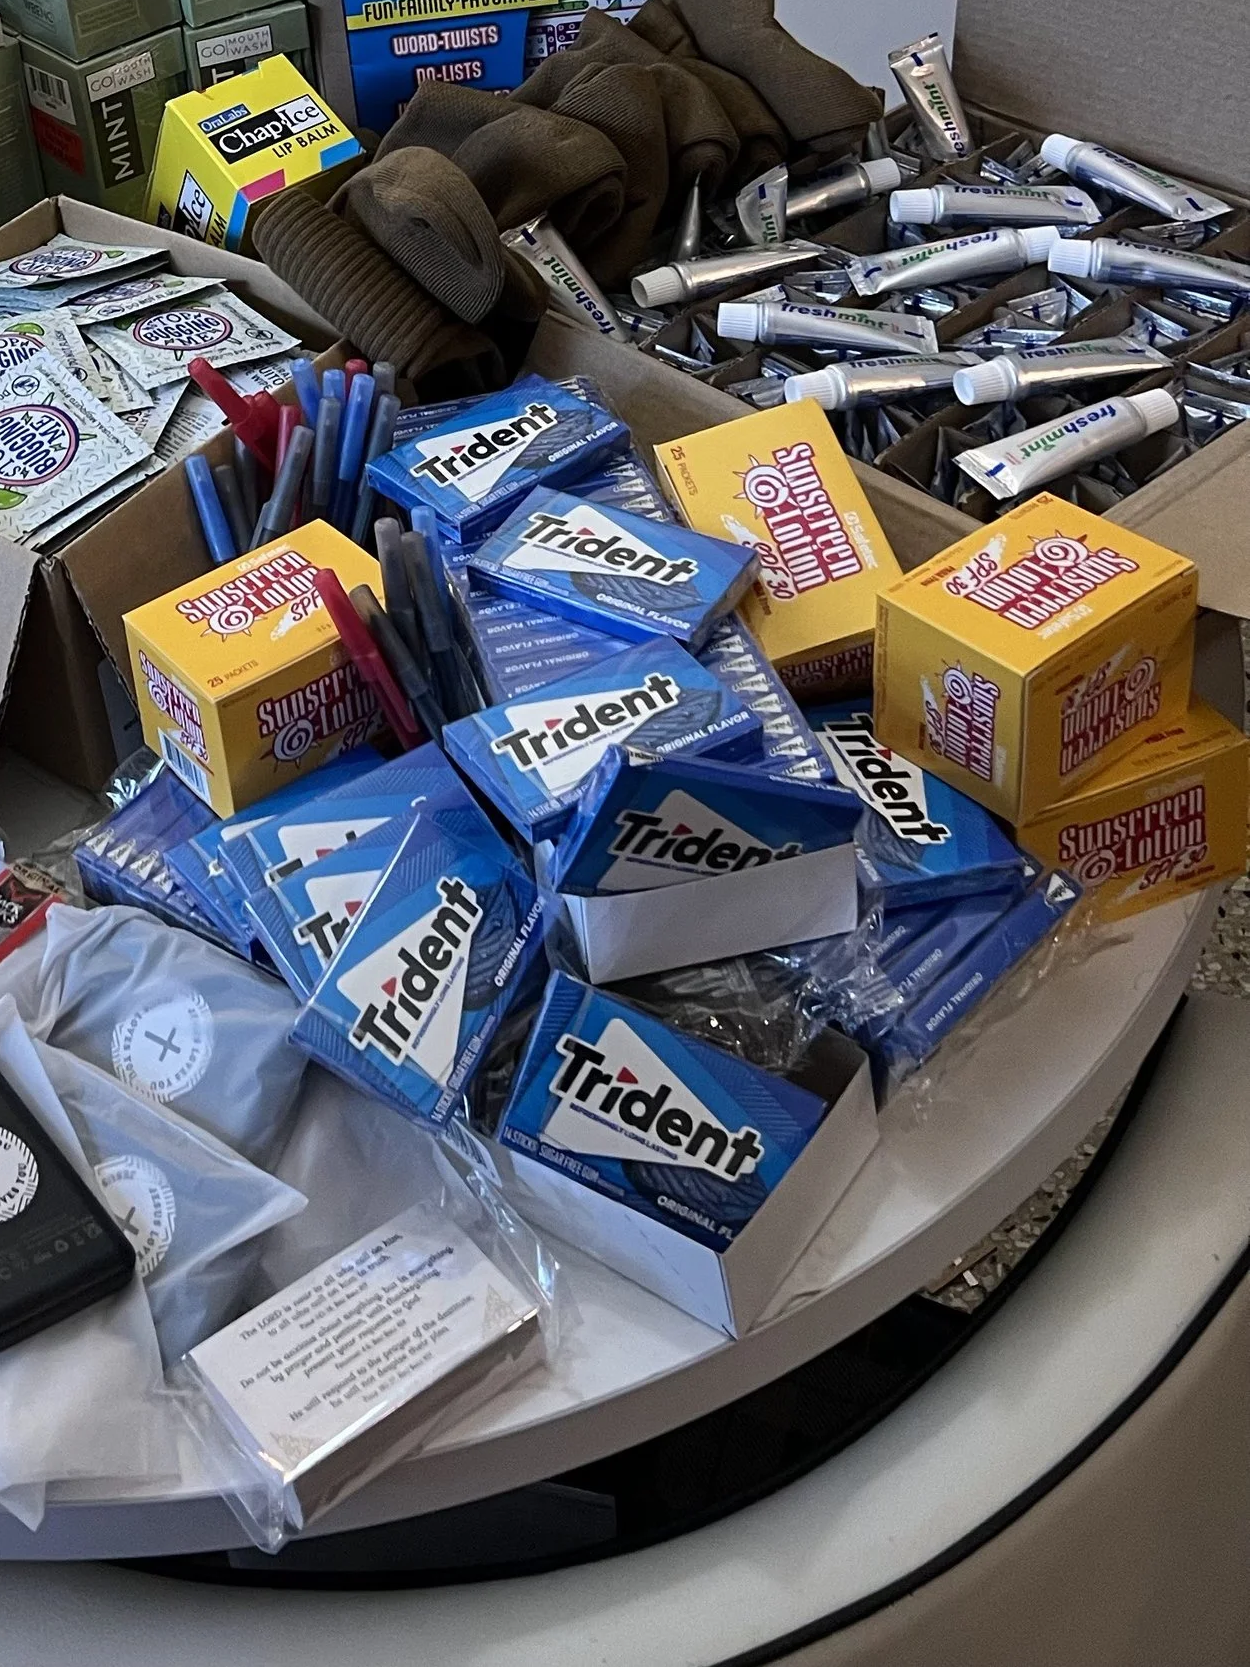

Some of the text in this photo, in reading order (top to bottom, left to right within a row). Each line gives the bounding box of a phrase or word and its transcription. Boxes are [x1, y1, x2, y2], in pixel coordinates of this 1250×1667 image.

[363, 1, 394, 23] FUN
[200, 29, 269, 58] GO MOUTH
[230, 40, 269, 55] WASH
[392, 25, 499, 56] WORD-TWISTS
[91, 76, 114, 93] GO
[117, 68, 151, 88] WASH
[102, 101, 134, 182] MINT
[200, 106, 249, 134] OraLabs
[272, 123, 340, 159] LIP BALM
[542, 255, 617, 336] freshmint
[781, 301, 890, 331] freshmint
[142, 316, 221, 344] BUGGING
[149, 311, 192, 330] STOP
[30, 414, 66, 443] ME
[413, 403, 558, 485] Trident
[547, 420, 620, 463] ORIGINAL FLAVOR
[1020, 404, 1117, 460] freshmint
[670, 445, 698, 496] 25 PACKETS
[772, 442, 863, 582] Sunscreen
[522, 512, 698, 583] Trident
[766, 506, 828, 594] Lotion
[176, 550, 316, 625] Sunscreen
[250, 565, 320, 615] Lotion
[766, 578, 795, 600] 30
[966, 556, 1045, 612] Lotion
[1002, 547, 1140, 630] Sunscreen
[596, 592, 691, 631] ORIGINAL FLAVOR
[207, 675, 223, 688] 25
[495, 675, 676, 768] Trident
[655, 711, 751, 754] ORIGINAL FLAVOR
[969, 671, 1001, 782] Sunscreen
[824, 713, 951, 844] Trident
[1060, 785, 1206, 863] Sunscreen
[1118, 816, 1206, 872] Lotion
[352, 877, 480, 1059] Trident
[494, 934, 526, 987] ORIGINAL
[553, 1037, 762, 1178] Trident
[16, 1161, 29, 1186] YOU
[657, 1195, 718, 1233] ORIGINAL
[238, 1326, 258, 1342] The
[257, 1308, 283, 1332] LORD
